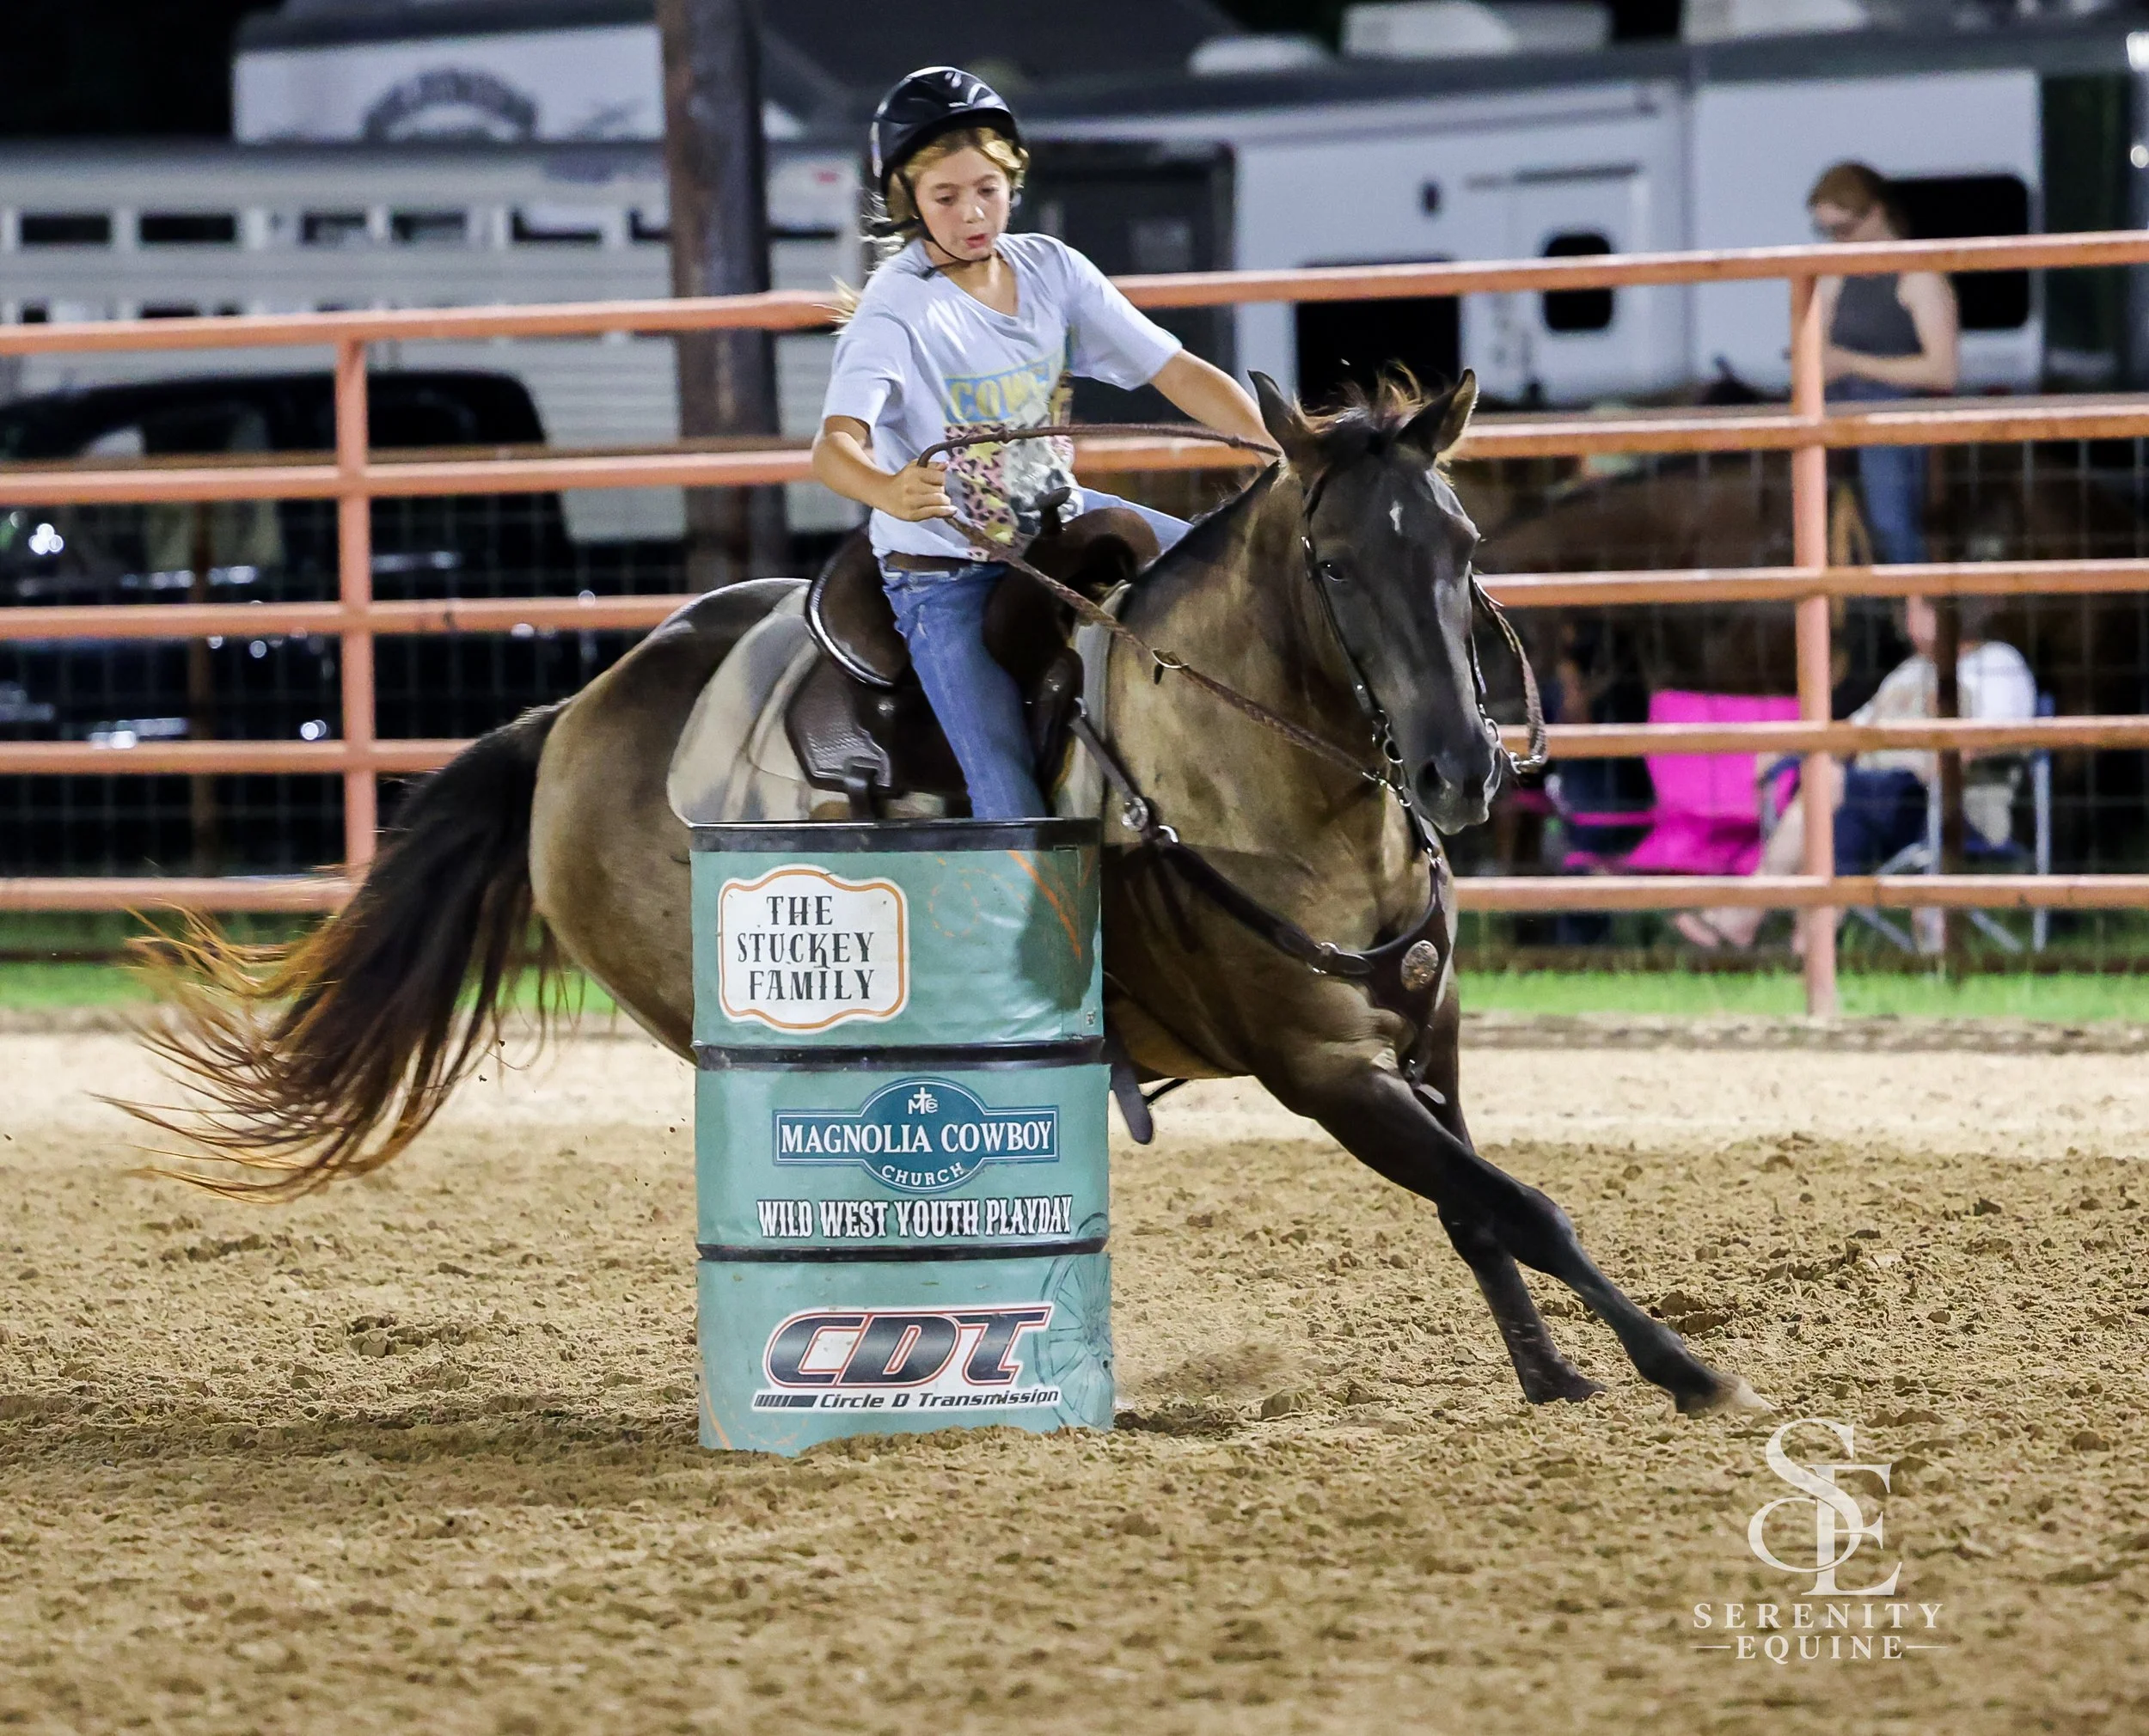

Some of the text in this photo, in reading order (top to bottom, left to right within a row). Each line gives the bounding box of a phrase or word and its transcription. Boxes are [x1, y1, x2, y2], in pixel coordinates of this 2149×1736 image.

[766, 895, 833, 926] THE
[738, 932, 875, 969] STUCKEY
[750, 969, 875, 1000] FAMILY
[781, 1120, 1052, 1153] MAGNOLIA COWBOY
[881, 1161, 964, 1186] CHURCH
[756, 1195, 1072, 1238] WILD WEST YOUTH PLAYDAY
[765, 1305, 1051, 1389] CDT
[820, 1389, 1059, 1409] Circle D Transmission
